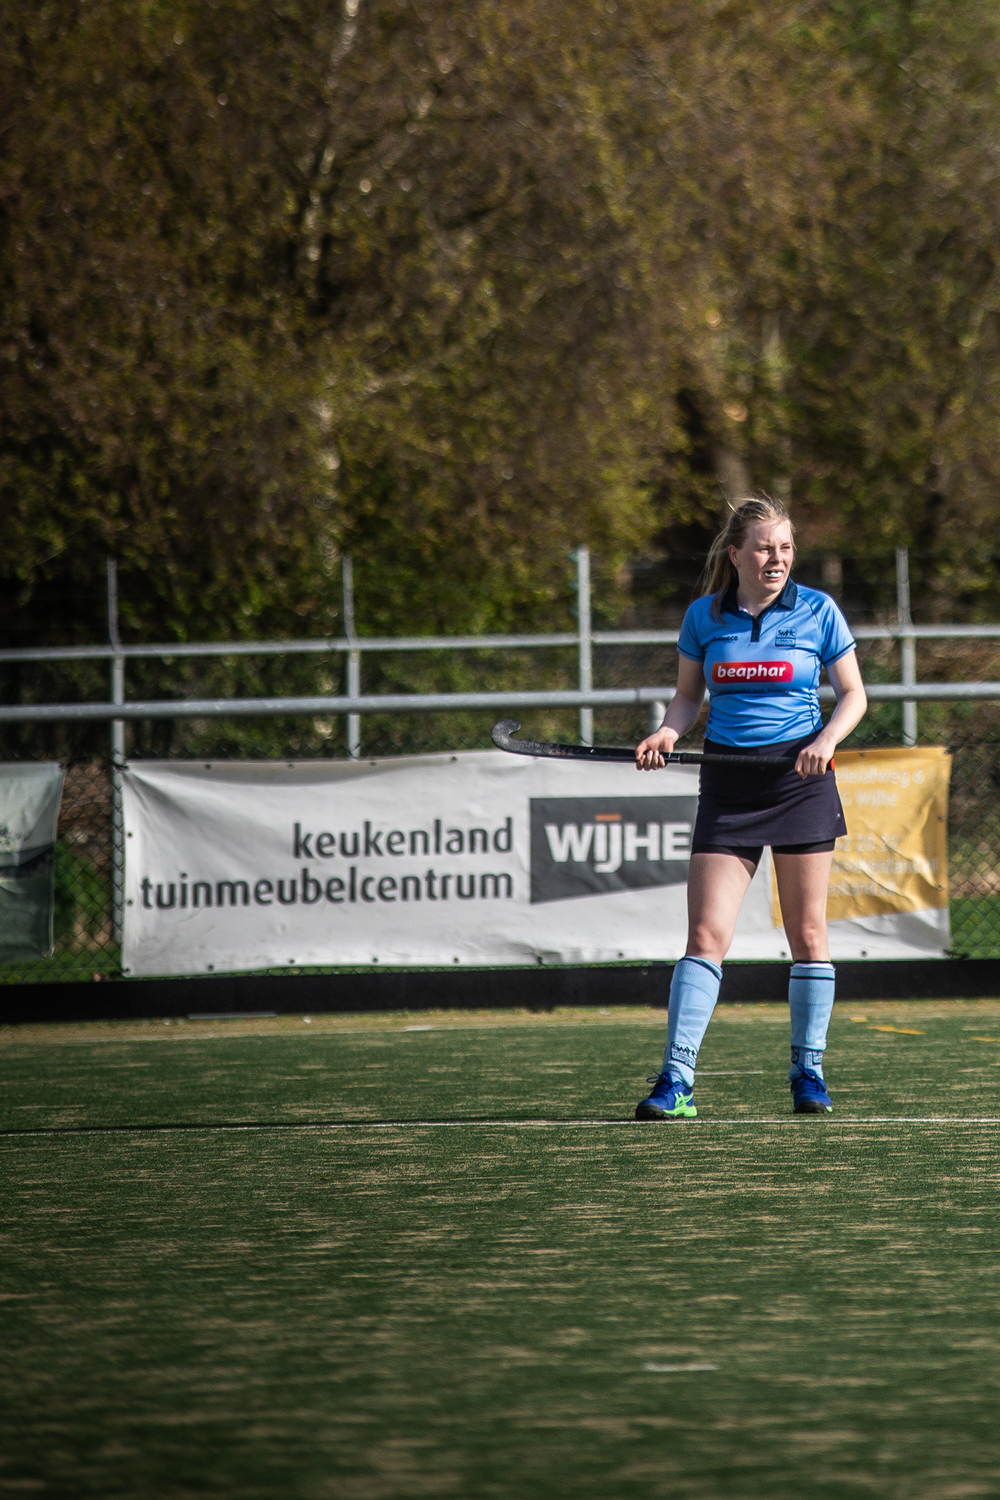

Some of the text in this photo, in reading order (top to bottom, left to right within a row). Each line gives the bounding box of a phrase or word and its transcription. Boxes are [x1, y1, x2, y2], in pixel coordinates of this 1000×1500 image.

[717, 664, 787, 680] beaphar
[912, 768, 924, 784] 6
[854, 788, 899, 810] Wijhe
[292, 816, 513, 860] keukenland
[856, 835, 875, 851] 20
[140, 866, 513, 910] tuinmeubelcentrum
